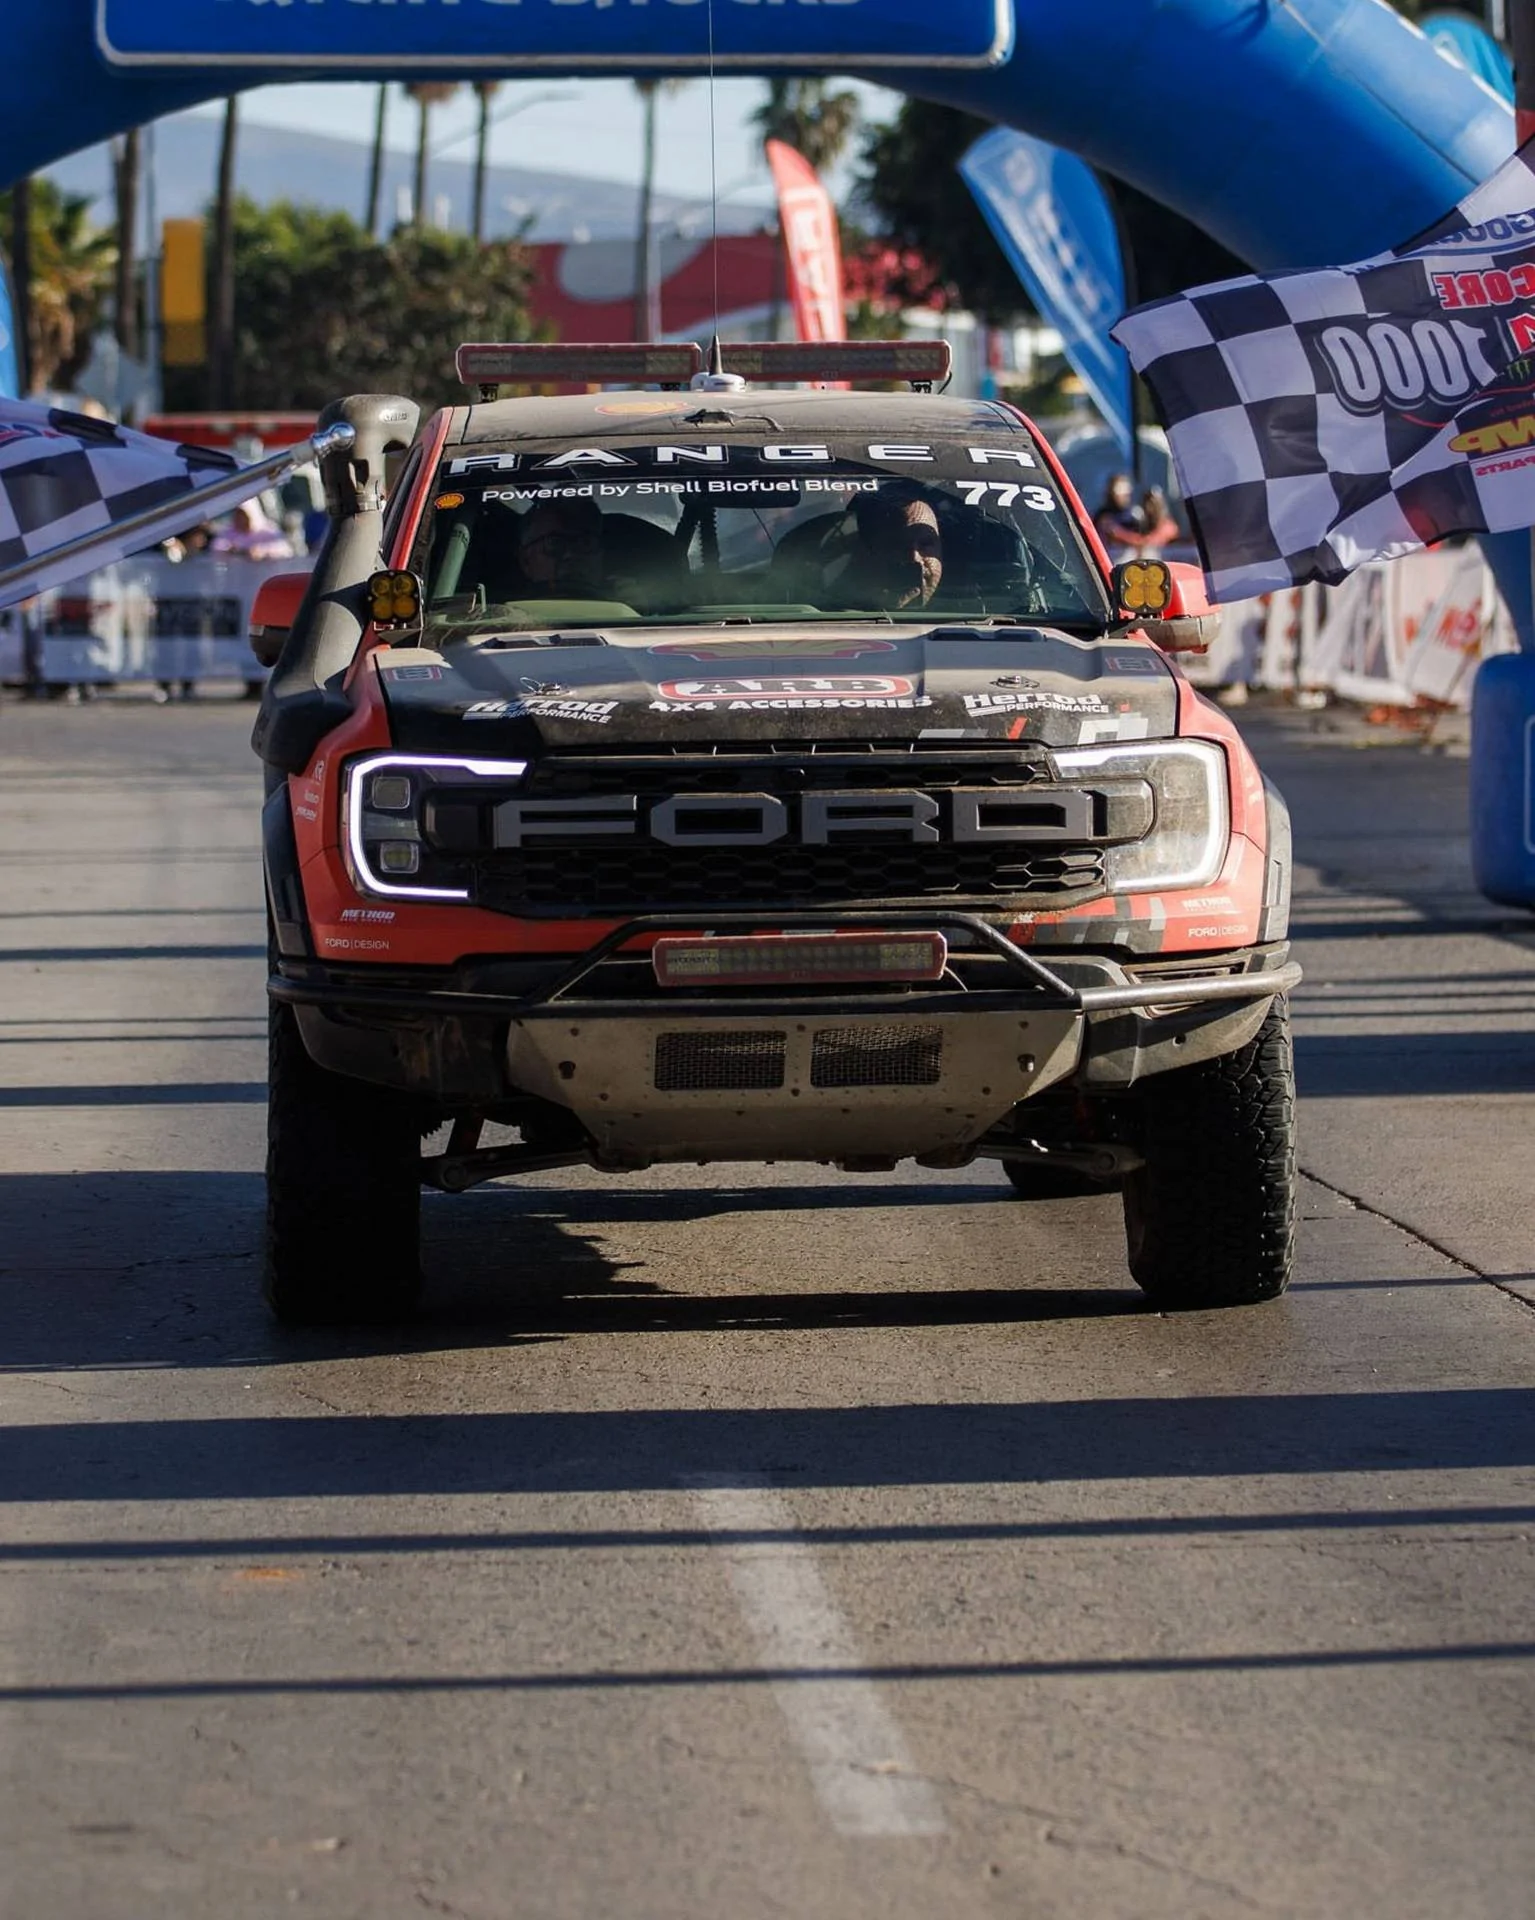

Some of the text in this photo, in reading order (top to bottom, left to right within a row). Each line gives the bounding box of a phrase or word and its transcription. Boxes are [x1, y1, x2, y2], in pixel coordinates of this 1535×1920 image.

[446, 442, 1038, 477] RANGER
[482, 477, 879, 503] Powered by Shell Biofuel Blend
[955, 480, 1056, 512] 773
[728, 696, 933, 710] ACCESSORIES
[962, 692, 1104, 710] Herrod
[1005, 702, 1109, 714] PERFORMANCE
[499, 706, 612, 724] PERFORMANCE
[494, 789, 1095, 850] FORD
